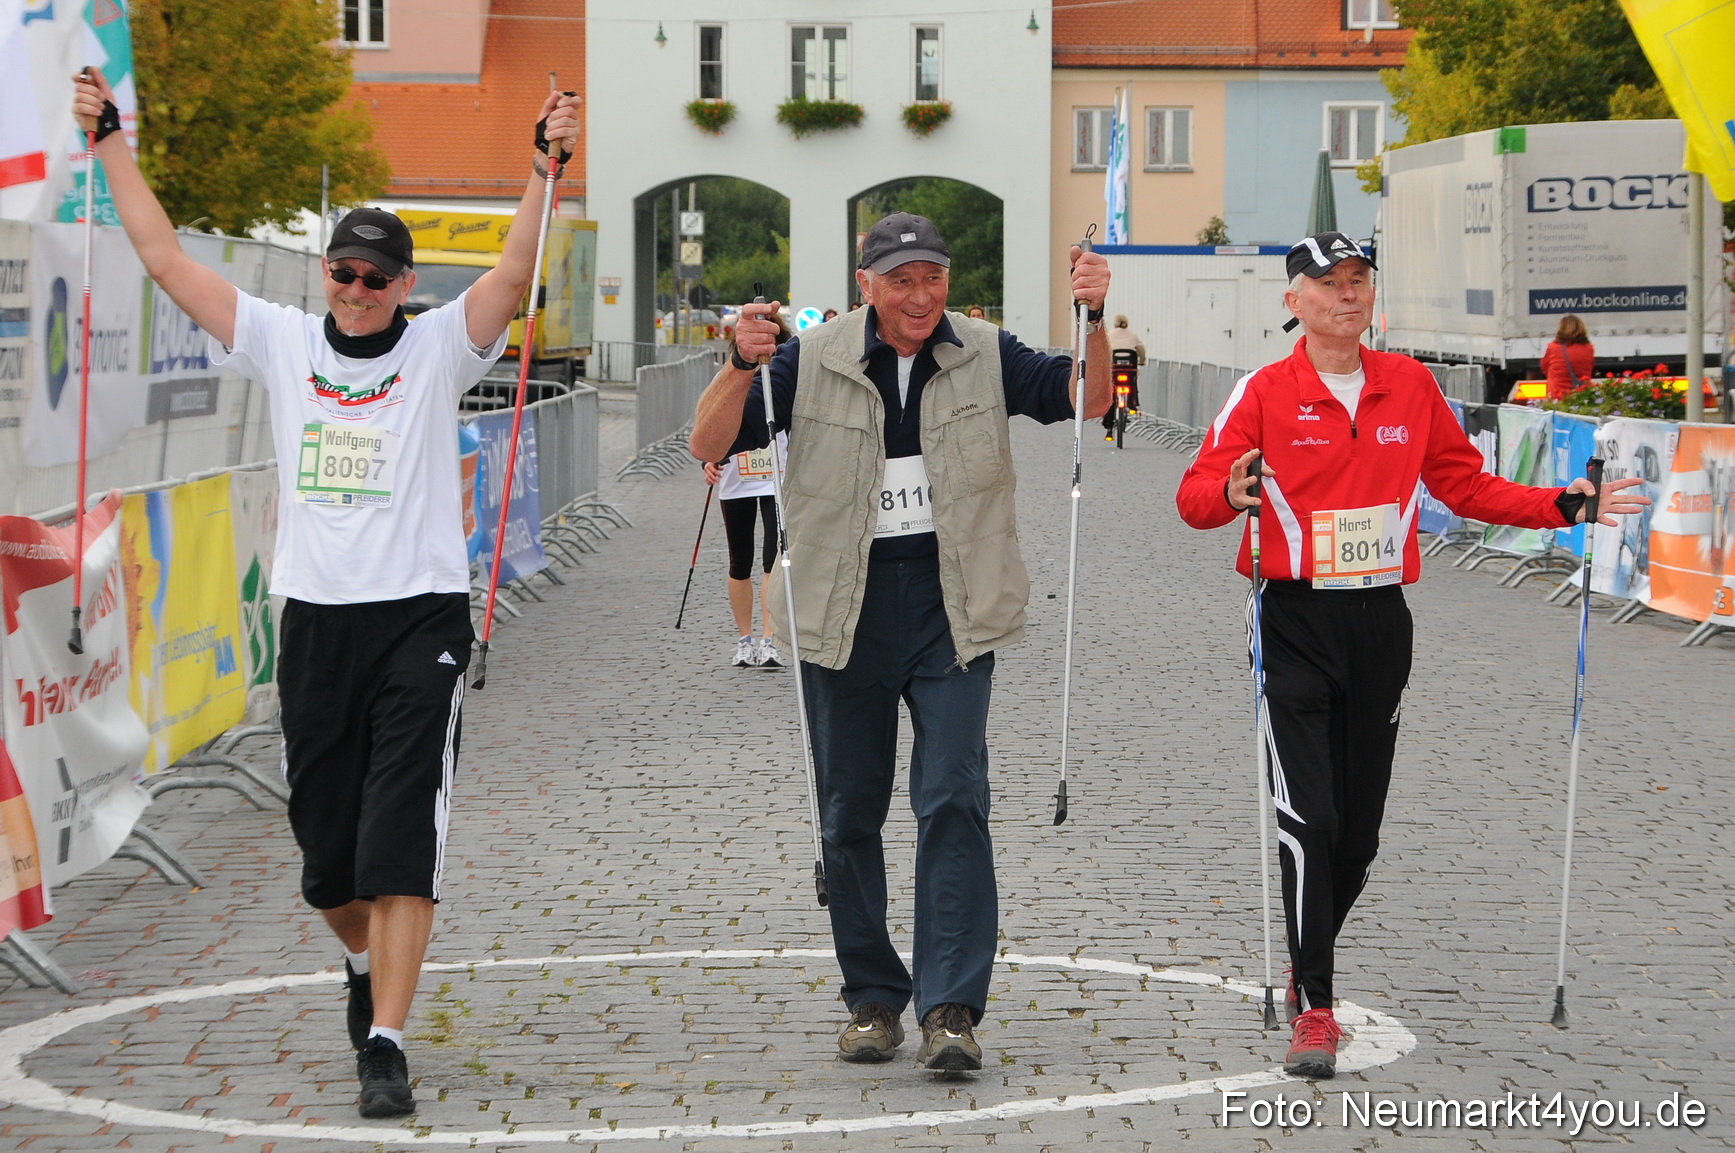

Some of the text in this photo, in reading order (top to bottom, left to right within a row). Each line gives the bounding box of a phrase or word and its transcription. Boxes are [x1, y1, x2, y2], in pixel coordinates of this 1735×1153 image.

[1527, 174, 1689, 213] BOCK
[1538, 222, 1589, 232] Entwicklung
[1538, 233, 1586, 241] Formenbau
[324, 430, 382, 453] Wolfgang
[323, 455, 387, 480] 8097
[751, 457, 773, 469] 804
[352, 494, 391, 504] PFLEIDERER
[1338, 517, 1372, 532] Horst
[1341, 537, 1396, 563] 8014
